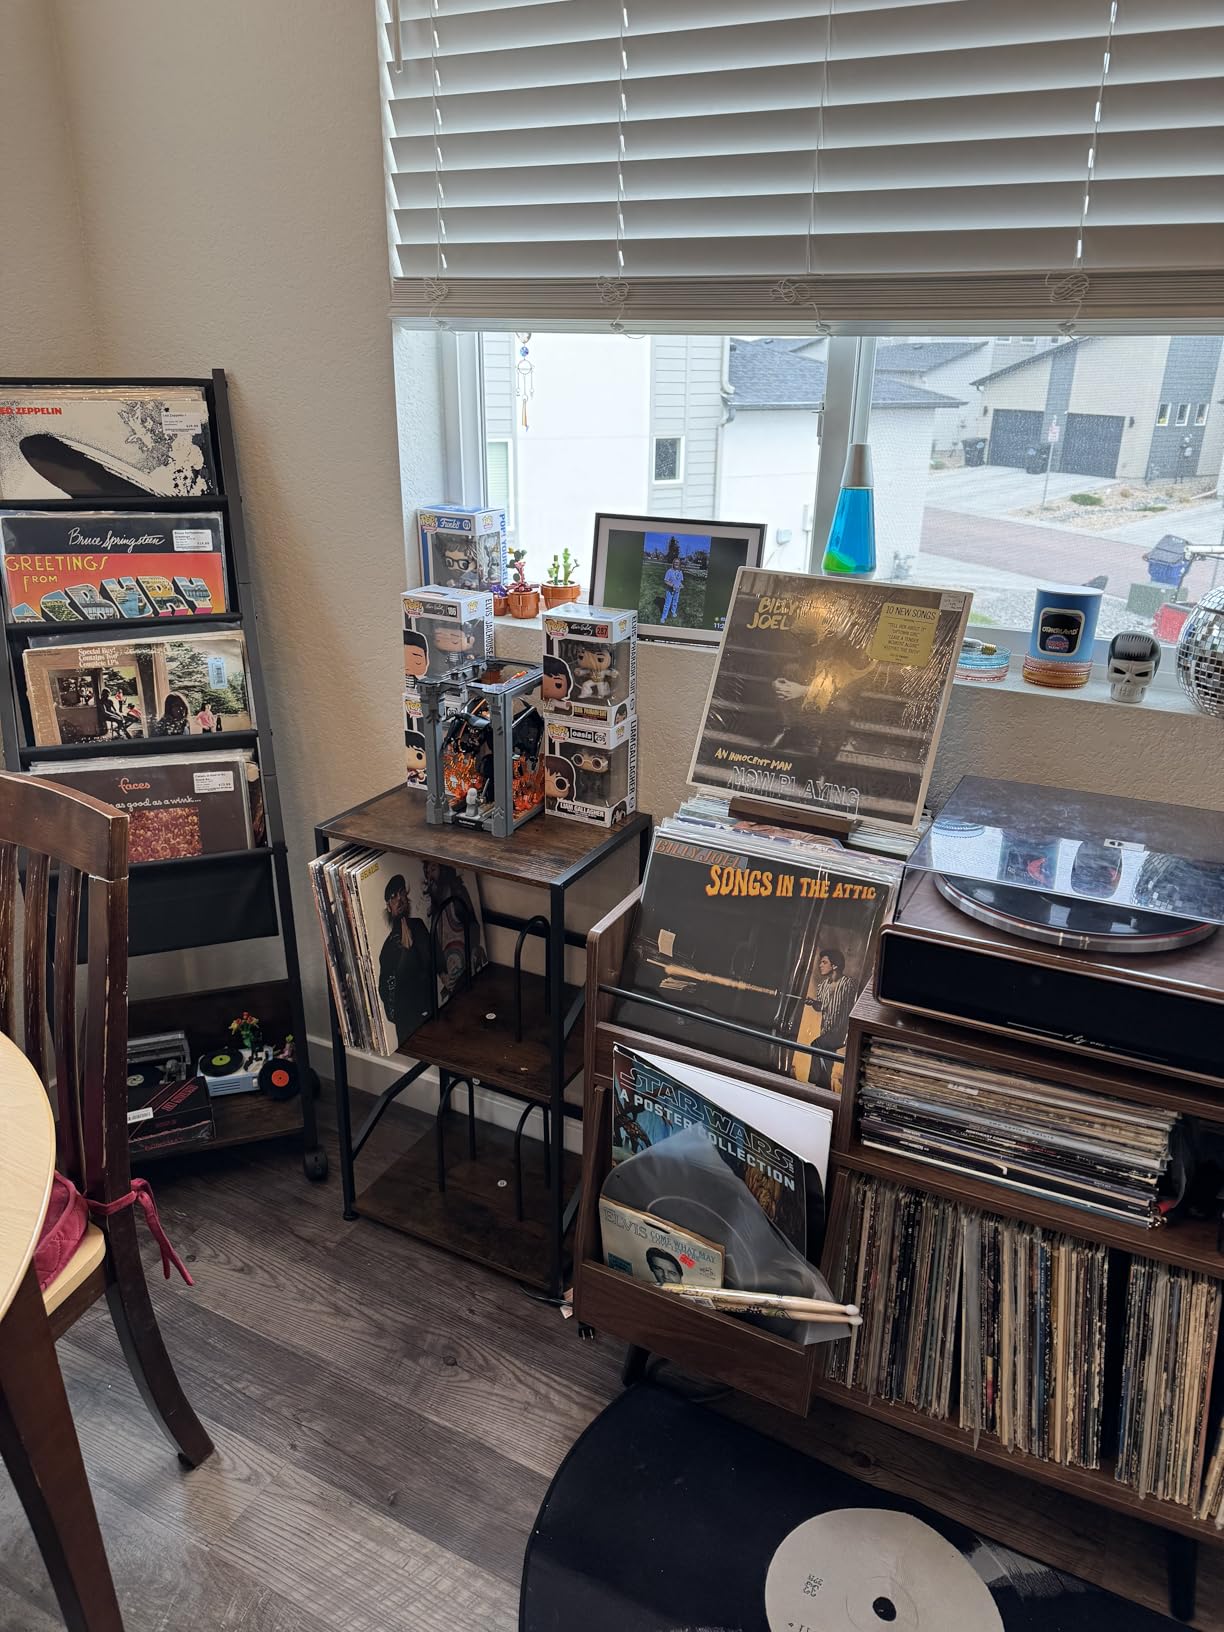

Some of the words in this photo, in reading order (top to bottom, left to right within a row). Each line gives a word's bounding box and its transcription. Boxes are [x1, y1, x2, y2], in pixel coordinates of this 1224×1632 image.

[0, 407, 13, 415] ED
[15, 407, 62, 415] ZEPPELIN
[440, 517, 460, 529] Funko
[68, 527, 102, 546] Bruce
[101, 531, 165, 553] Springsteen
[4, 555, 108, 572] GREETINGS
[500, 540, 508, 584] YOURSEL
[23, 575, 58, 593] FROM
[485, 598, 493, 617] ELVIS
[758, 597, 798, 616] BILLY
[885, 605, 894, 615] 10
[895, 606, 912, 617] NEW
[912, 608, 936, 621] SONGS
[746, 612, 790, 631] JOEL
[485, 621, 494, 657] JAILHOUSE
[78, 648, 101, 657] Special
[102, 647, 116, 656] Buy!
[78, 654, 105, 662] Contains
[78, 660, 106, 669] Complete
[571, 730, 592, 740] oasis
[629, 720, 637, 743] LIAM
[714, 748, 729, 760] AN
[728, 751, 770, 767] INNOCENT
[770, 759, 793, 772] MAN
[118, 777, 151, 794] faces
[731, 766, 774, 791] NOW
[127, 798, 152, 812] good
[654, 838, 700, 860] BILLY
[700, 849, 742, 870] JOEL
[704, 864, 773, 897] SONGS
[776, 873, 795, 897] IN
[799, 877, 831, 899] THE
[832, 882, 877, 900] ATTIC
[619, 1088, 630, 1102] A
[634, 1094, 695, 1131] POSTER
[620, 1067, 705, 1121] STAR
[703, 1104, 795, 1170] WARS
[603, 1206, 648, 1240] ELVIS
[650, 1230, 672, 1246] COME
[673, 1239, 696, 1257] WHAT
[698, 1250, 717, 1265] MAY
